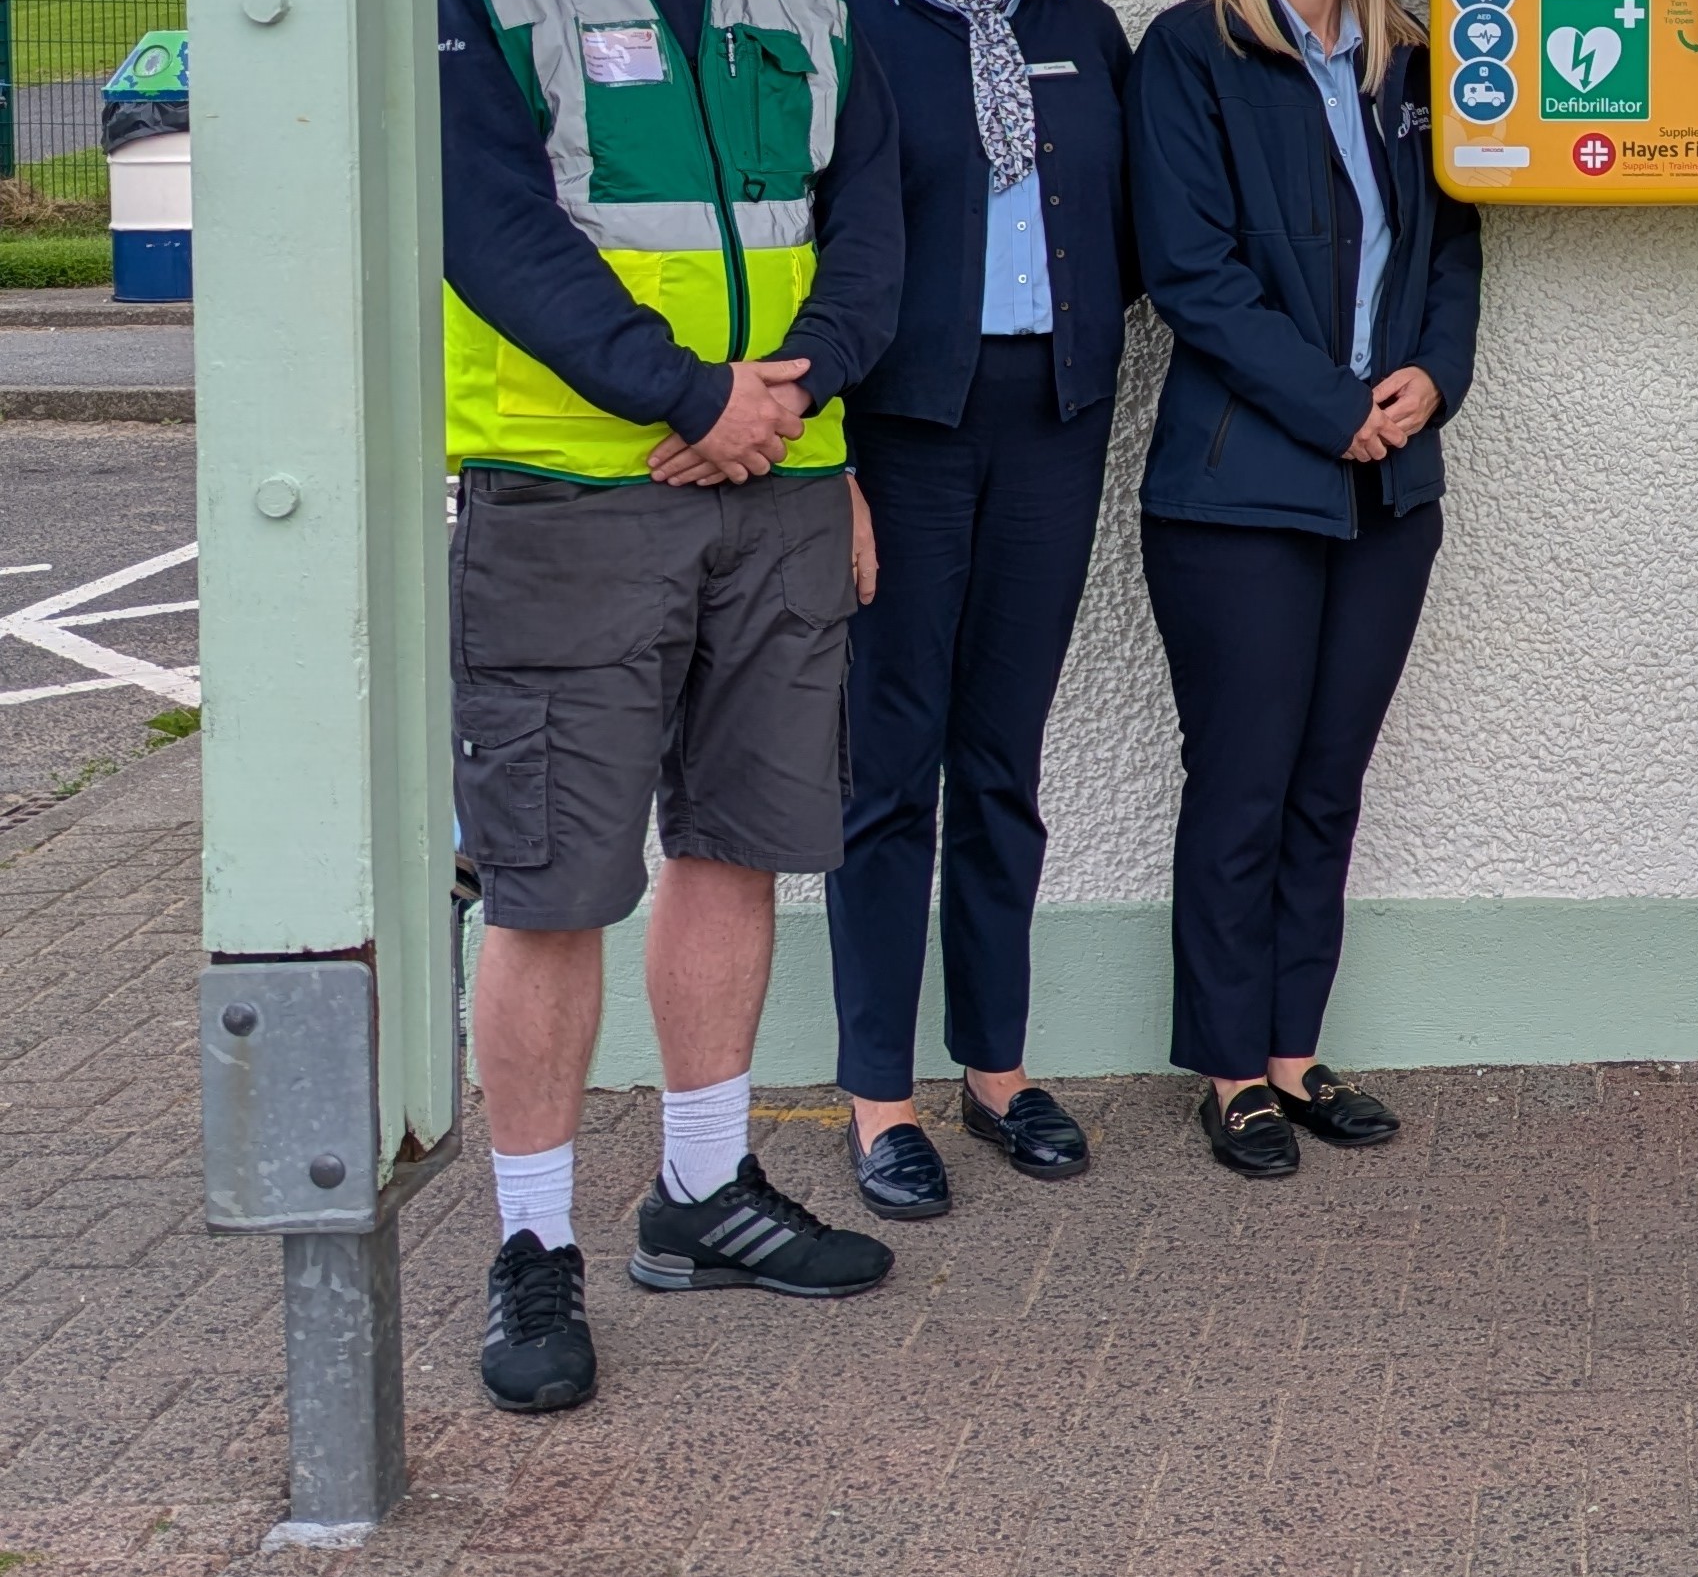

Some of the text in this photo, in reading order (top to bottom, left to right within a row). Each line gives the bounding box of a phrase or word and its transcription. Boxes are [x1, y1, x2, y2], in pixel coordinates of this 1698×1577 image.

[1476, 13, 1492, 21] AED
[1545, 96, 1643, 113] Defibrillator
[1622, 141, 1679, 161] Hayes
[1622, 161, 1659, 172] Supplies
